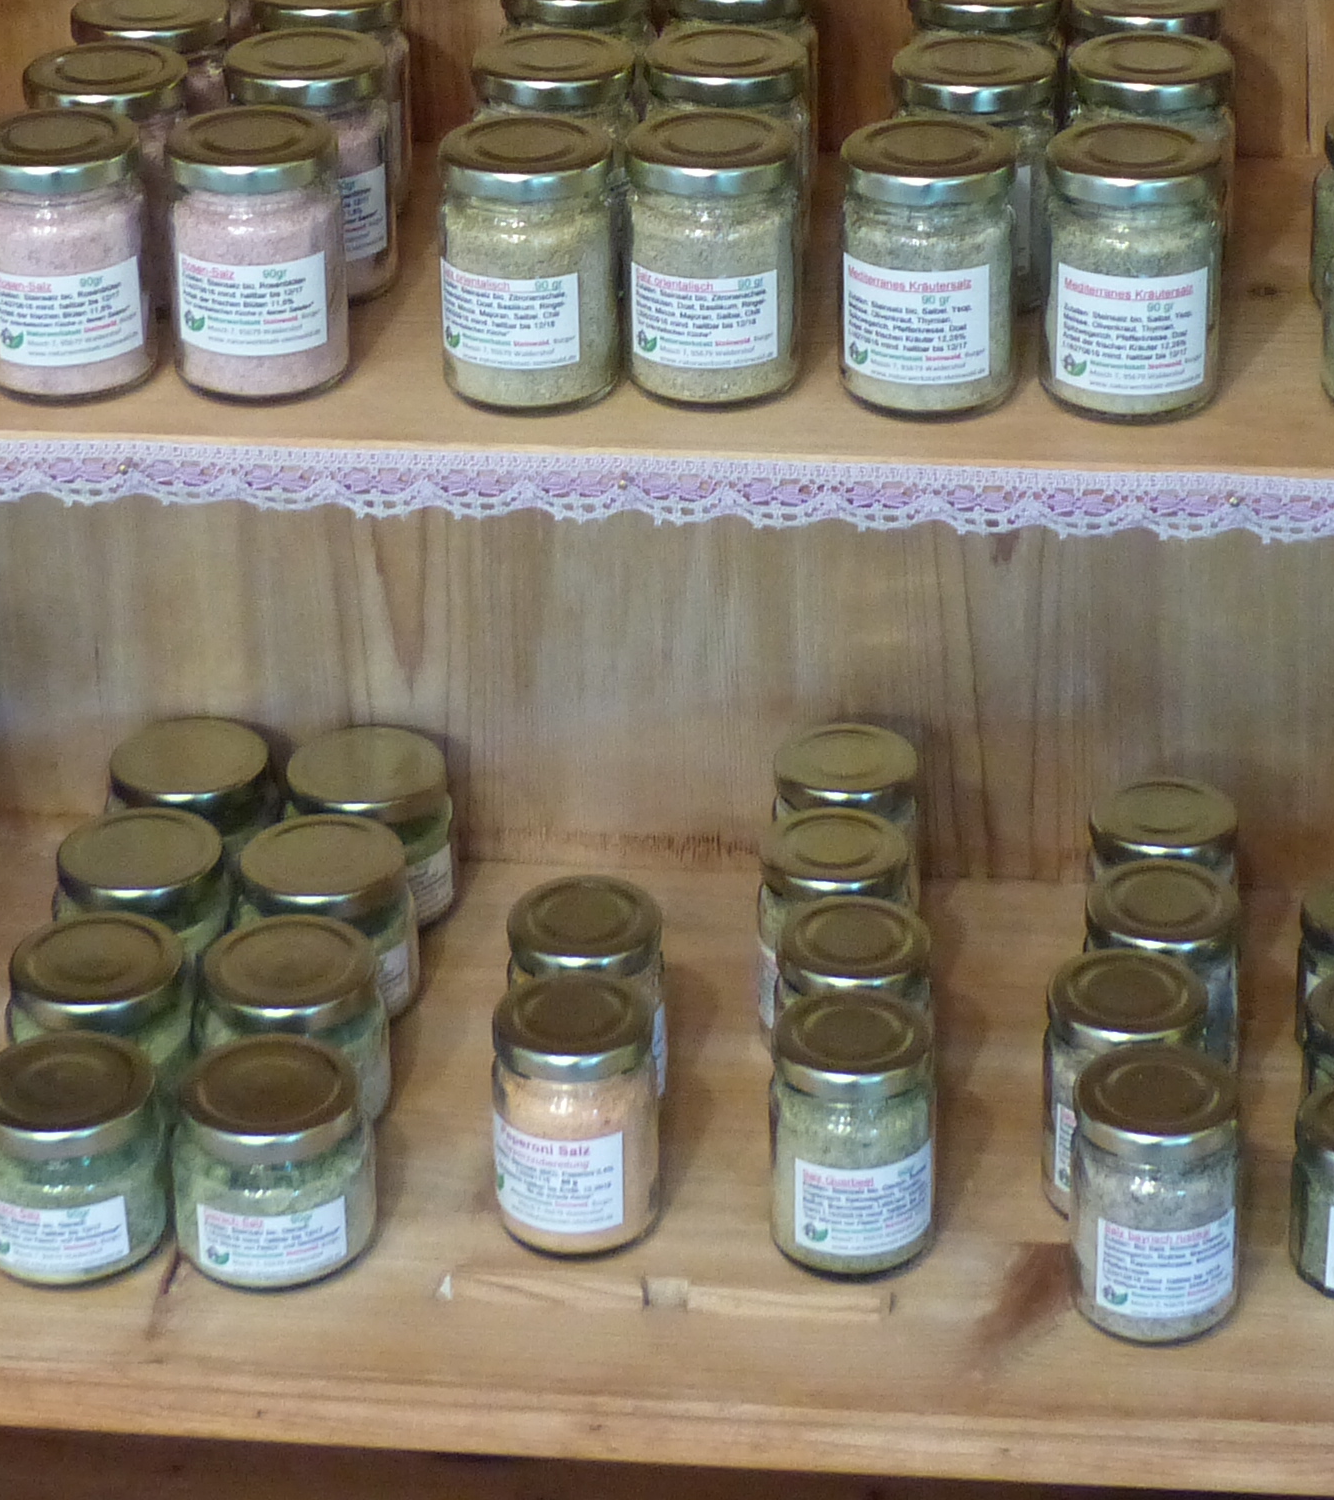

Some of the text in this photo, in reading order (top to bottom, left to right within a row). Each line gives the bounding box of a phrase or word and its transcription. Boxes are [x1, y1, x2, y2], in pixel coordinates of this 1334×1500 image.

[263, 269, 287, 280] 90gr
[909, 279, 972, 292] Kräutersalz
[922, 295, 951, 306] 90 gr
[1147, 302, 1173, 313] 90 gr
[559, 1145, 590, 1156] Salz
